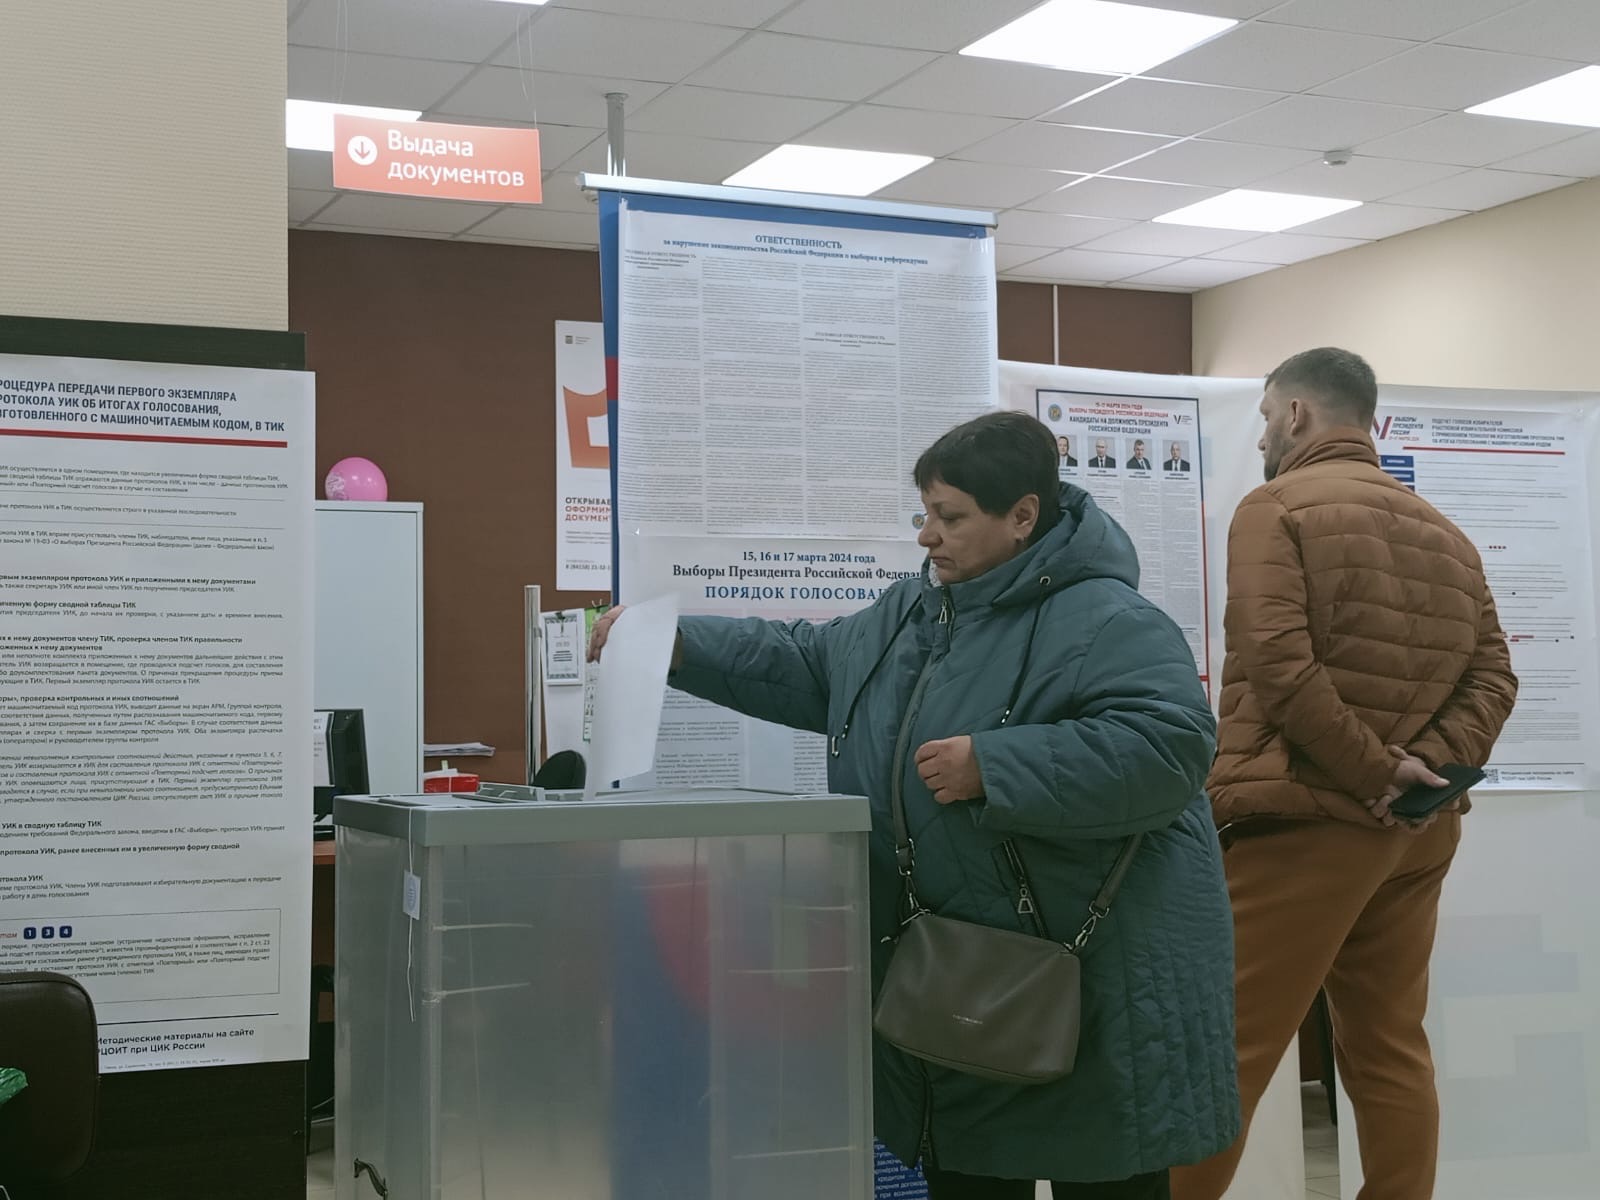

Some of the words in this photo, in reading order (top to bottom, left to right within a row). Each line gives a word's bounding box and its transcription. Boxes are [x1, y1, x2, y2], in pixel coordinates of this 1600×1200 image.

[387, 129, 474, 157] Выдача
[387, 161, 525, 187] документов
[755, 234, 842, 251] ОТВЕТСТВЕННОСТЬ
[57, 382, 114, 396] ПЕРЕДАЧИ
[117, 385, 165, 397] ПЕРВОГО
[167, 388, 236, 401] ЭКЗЕМПЛЯРА
[57, 396, 79, 407] УИК
[81, 397, 95, 408] ОБ
[98, 398, 139, 410] ИТОГАХ
[142, 401, 221, 414] ГОЛОСОВАНИЯ,
[90, 413, 97, 422] С
[100, 413, 209, 428] МАШИНОЧИТАЕМЫМ
[212, 418, 252, 431] КОДОМ,
[255, 420, 261, 430] В
[264, 421, 284, 431] ТИК
[743, 551, 756, 561] 15,
[760, 551, 771, 561] 16
[773, 553, 780, 561] и
[783, 552, 794, 561] 17
[796, 554, 826, 564] марта
[828, 552, 851, 562] 2024
[854, 555, 875, 564] года
[672, 564, 724, 579] Выборы
[728, 565, 801, 579] Президента
[803, 566, 872, 578] Российской
[705, 585, 784, 598] ПОРЯДОК
[163, 1032, 213, 1040] материалы
[229, 1028, 254, 1037] сайте
[130, 1043, 148, 1054] при
[150, 1043, 170, 1052] ЦИК
[172, 1041, 205, 1050] России
